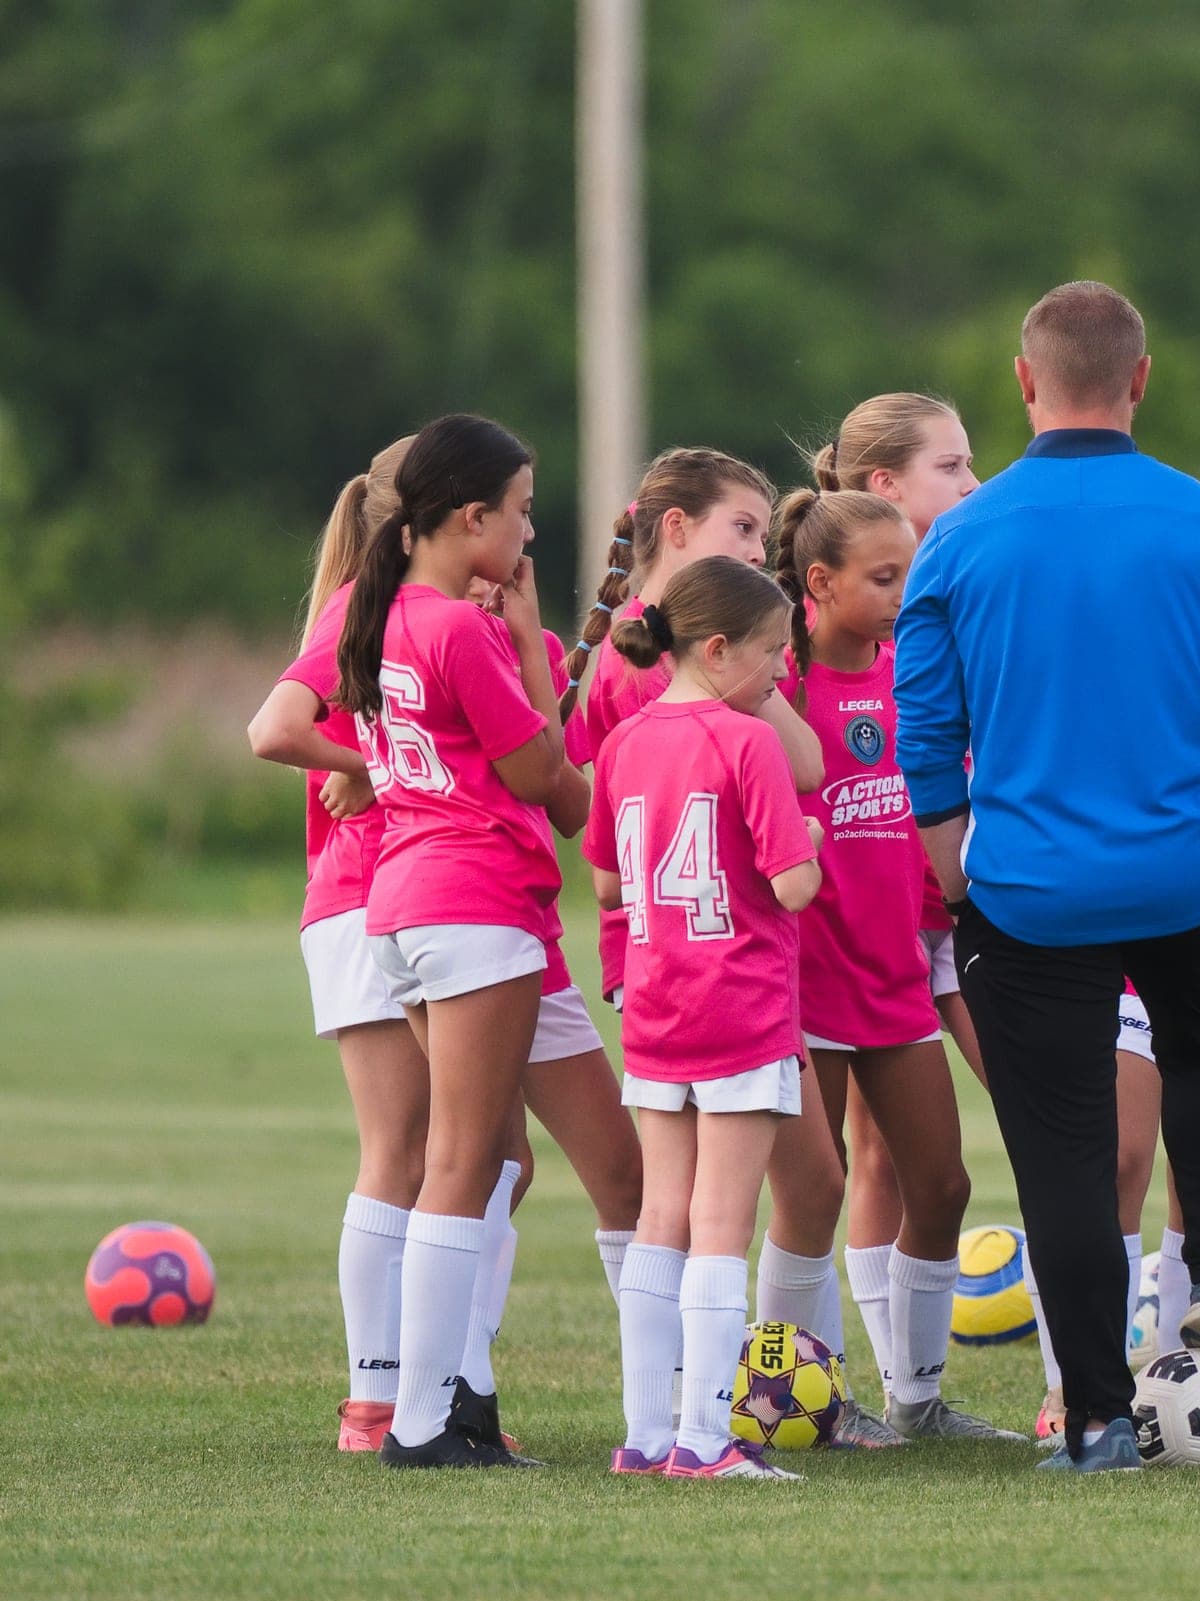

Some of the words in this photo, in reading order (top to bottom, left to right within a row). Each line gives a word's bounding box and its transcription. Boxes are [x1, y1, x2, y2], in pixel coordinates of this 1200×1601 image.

[838, 700, 884, 712] LEGEA
[834, 774, 906, 806] ACTION
[831, 795, 905, 826] SPORTS
[833, 829, 909, 841] go2actionsports.com
[614, 792, 736, 945] 44
[1118, 1015, 1153, 1032] EGEA
[760, 1320, 785, 1370] SELEC
[358, 1358, 400, 1370] LEG
